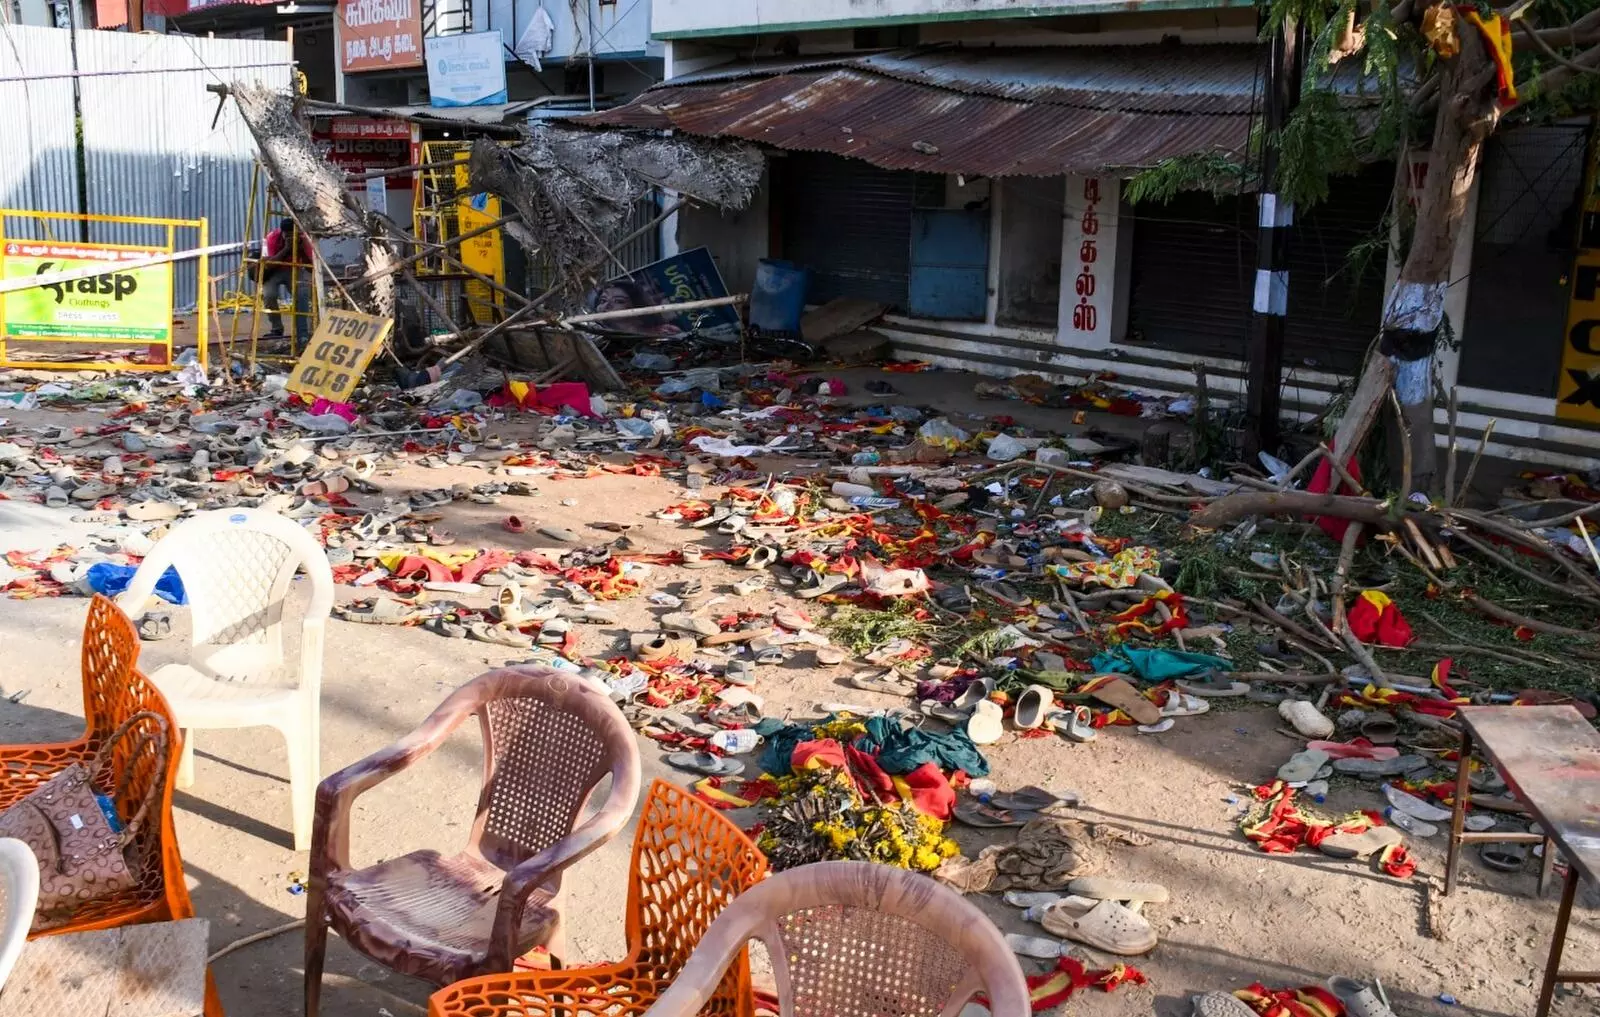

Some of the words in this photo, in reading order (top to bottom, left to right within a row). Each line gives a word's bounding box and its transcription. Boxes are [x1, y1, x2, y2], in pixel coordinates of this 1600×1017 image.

[345, 39, 368, 66] நகை
[368, 36, 393, 61] அடகு
[393, 33, 417, 54] கடை
[327, 315, 381, 342] LOCAL
[314, 341, 364, 368] ISD
[300, 366, 350, 392] STD
